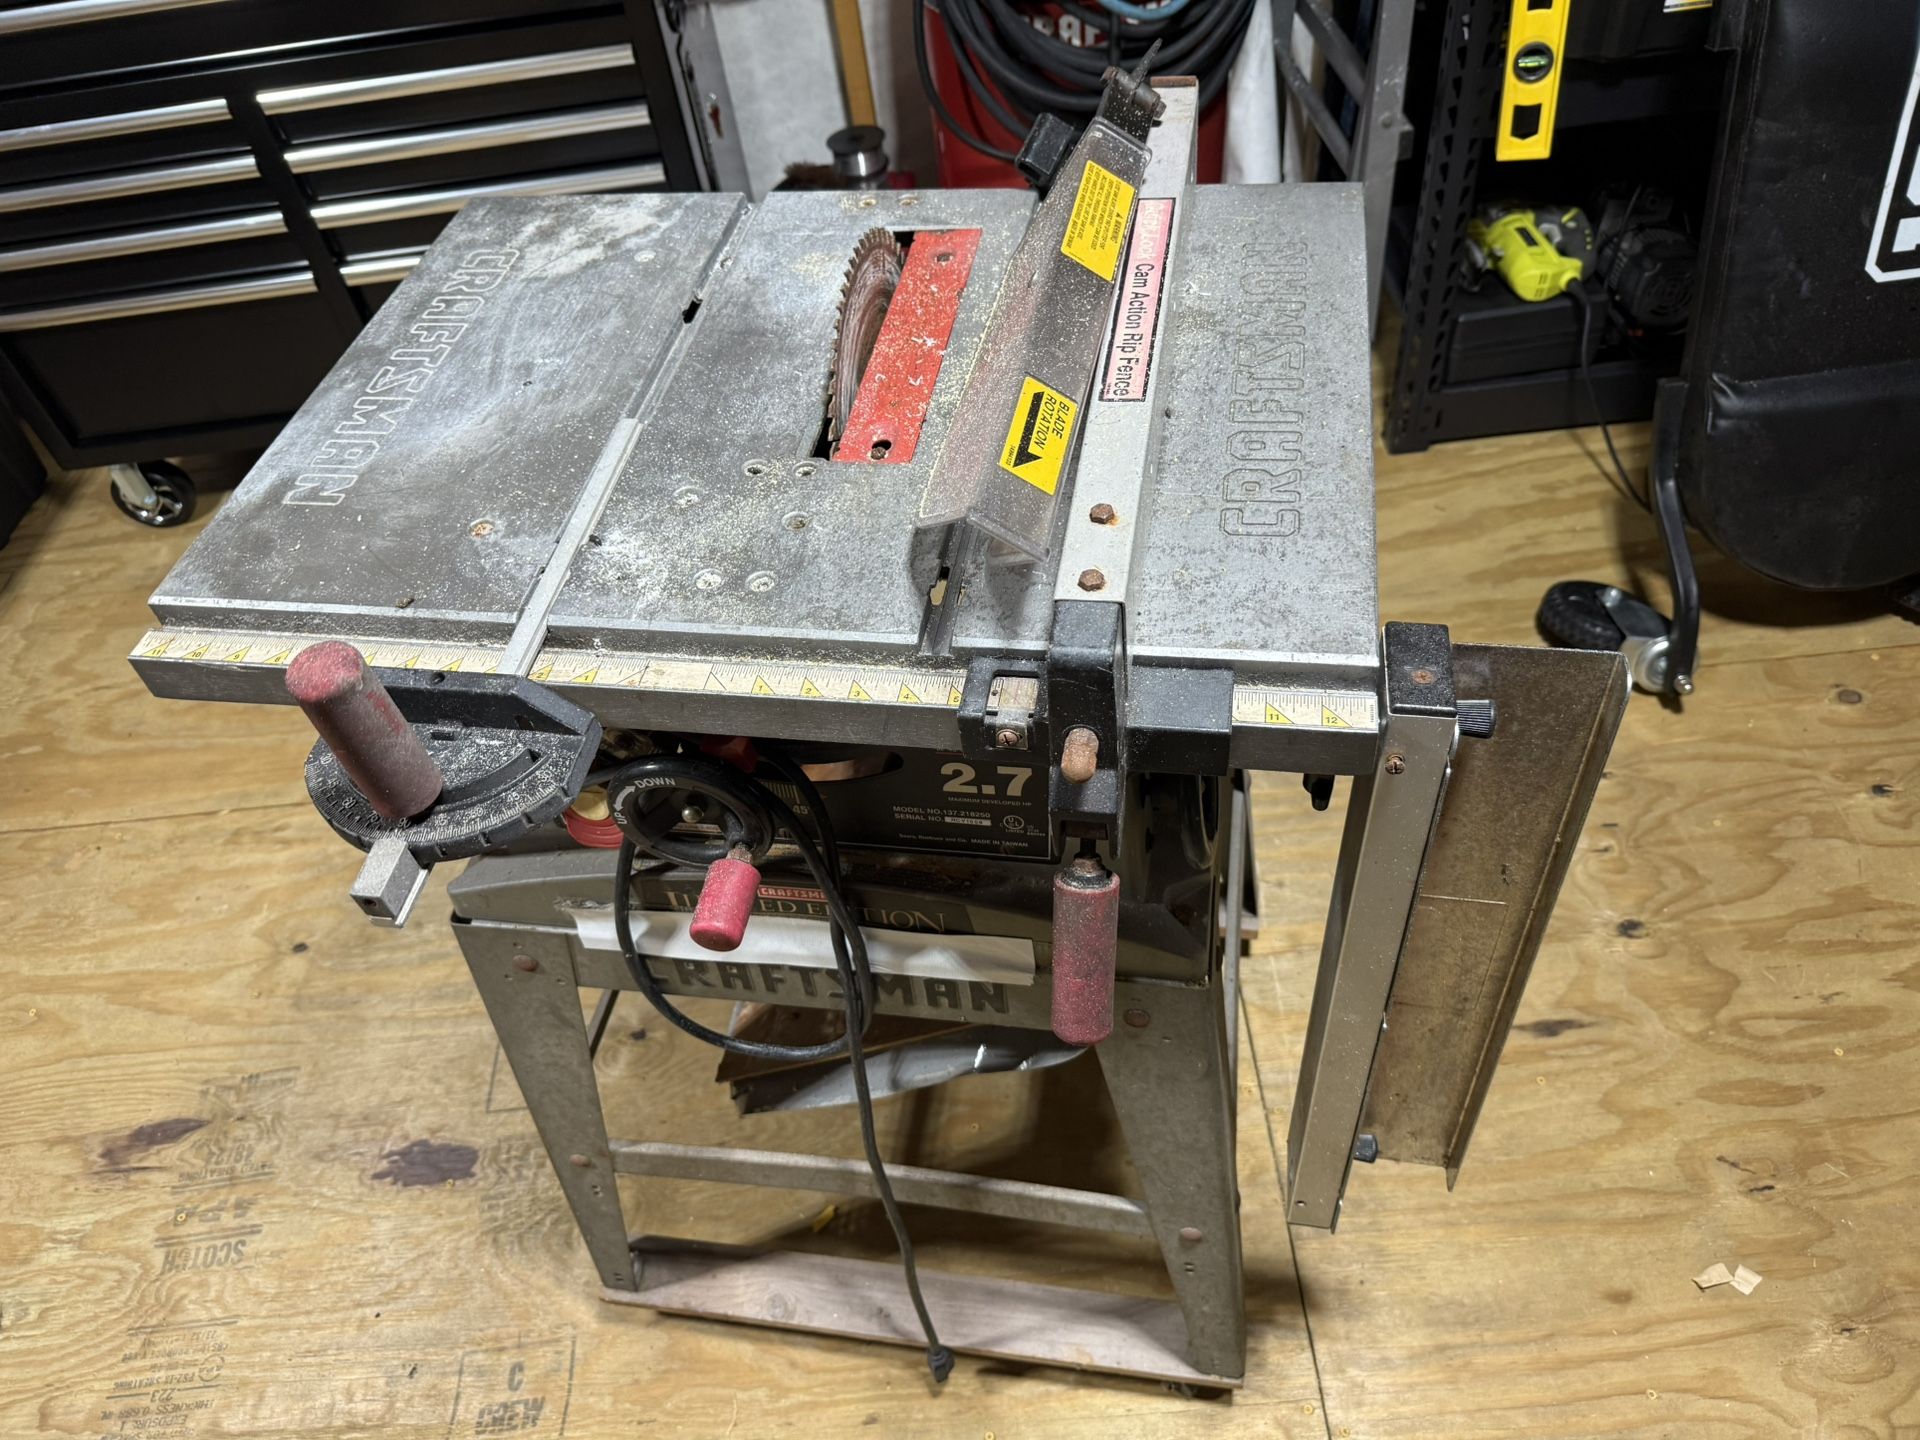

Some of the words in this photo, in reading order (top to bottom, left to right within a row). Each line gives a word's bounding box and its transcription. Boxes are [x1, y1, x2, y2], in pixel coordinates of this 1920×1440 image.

[1132, 263, 1155, 288] Cam
[1125, 291, 1150, 329] Action
[1116, 333, 1143, 354] Rip
[281, 249, 521, 506] CRAFTSMAN
[1113, 357, 1139, 396] Fence
[1219, 243, 1308, 537] CRAFTSMAN
[1034, 393, 1057, 449] ROTATION
[1052, 400, 1070, 439] BLADE
[1268, 713, 1280, 721] 11
[1325, 716, 1339, 724] 12
[634, 777, 676, 789] DOWN
[940, 762, 1033, 797] 2.7
[507, 791, 521, 802] 45
[981, 799, 1021, 807] DEVELOPED
[614, 812, 628, 825] UP
[893, 806, 925, 814] MODEL
[894, 813, 926, 821] SERIAL
[1001, 840, 1028, 848] TAIWAN
[760, 886, 827, 899] CRAFTSM
[665, 891, 797, 914] LIED
[808, 904, 945, 933] ETION
[160, 1239, 247, 1276] SCOTCH
[151, 1389, 174, 1402] 223
